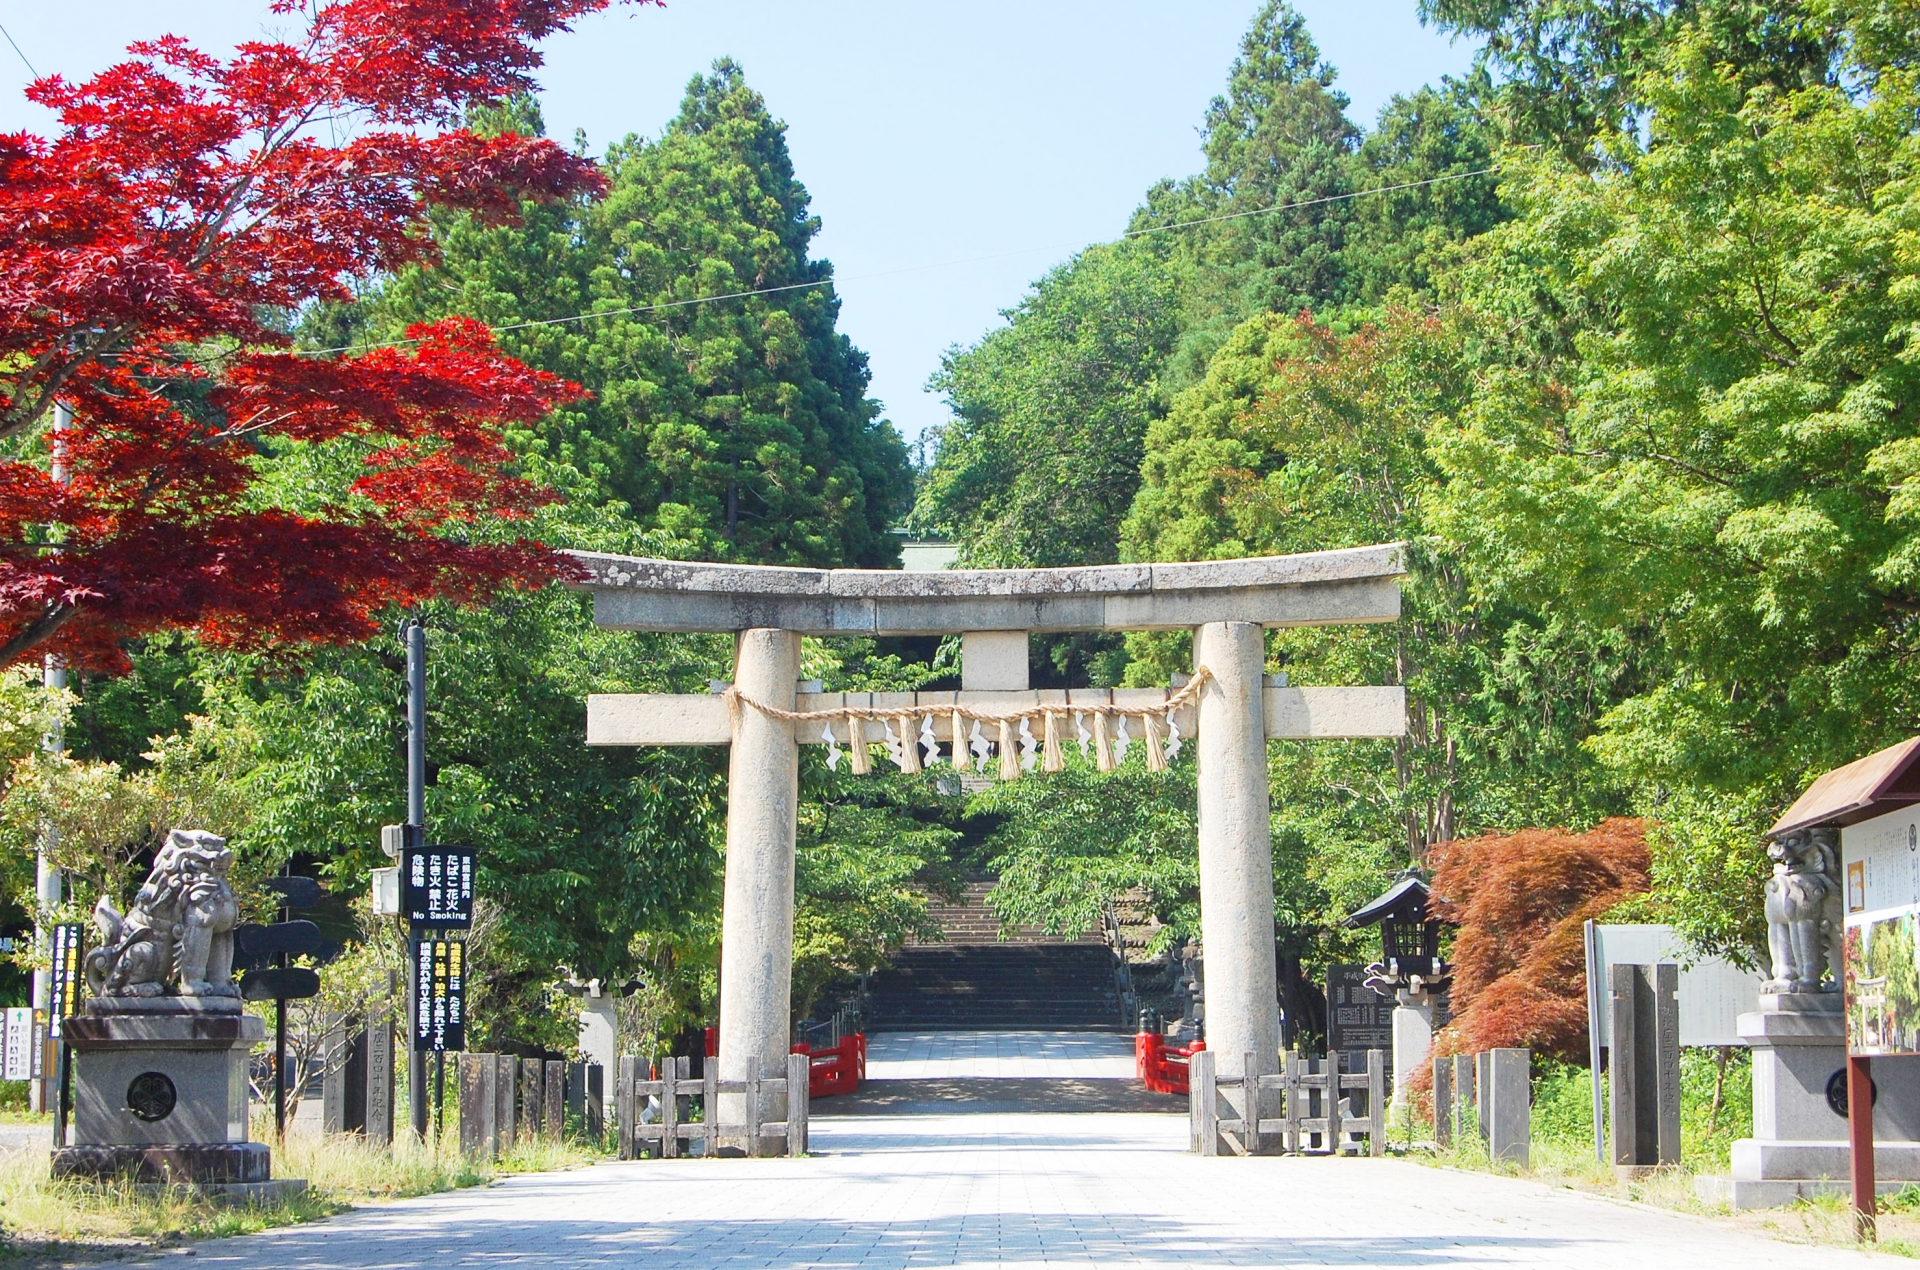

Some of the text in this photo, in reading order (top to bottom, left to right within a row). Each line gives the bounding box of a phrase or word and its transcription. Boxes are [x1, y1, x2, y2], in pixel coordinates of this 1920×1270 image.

[411, 854, 425, 888] 危険物
[428, 854, 442, 911] たき火 禁止
[446, 854, 459, 911] たばこ 花火
[412, 911, 467, 921] No Smoking
[65, 926, 78, 1018] この通路は駐停車
[449, 995, 460, 1024] ただちに
